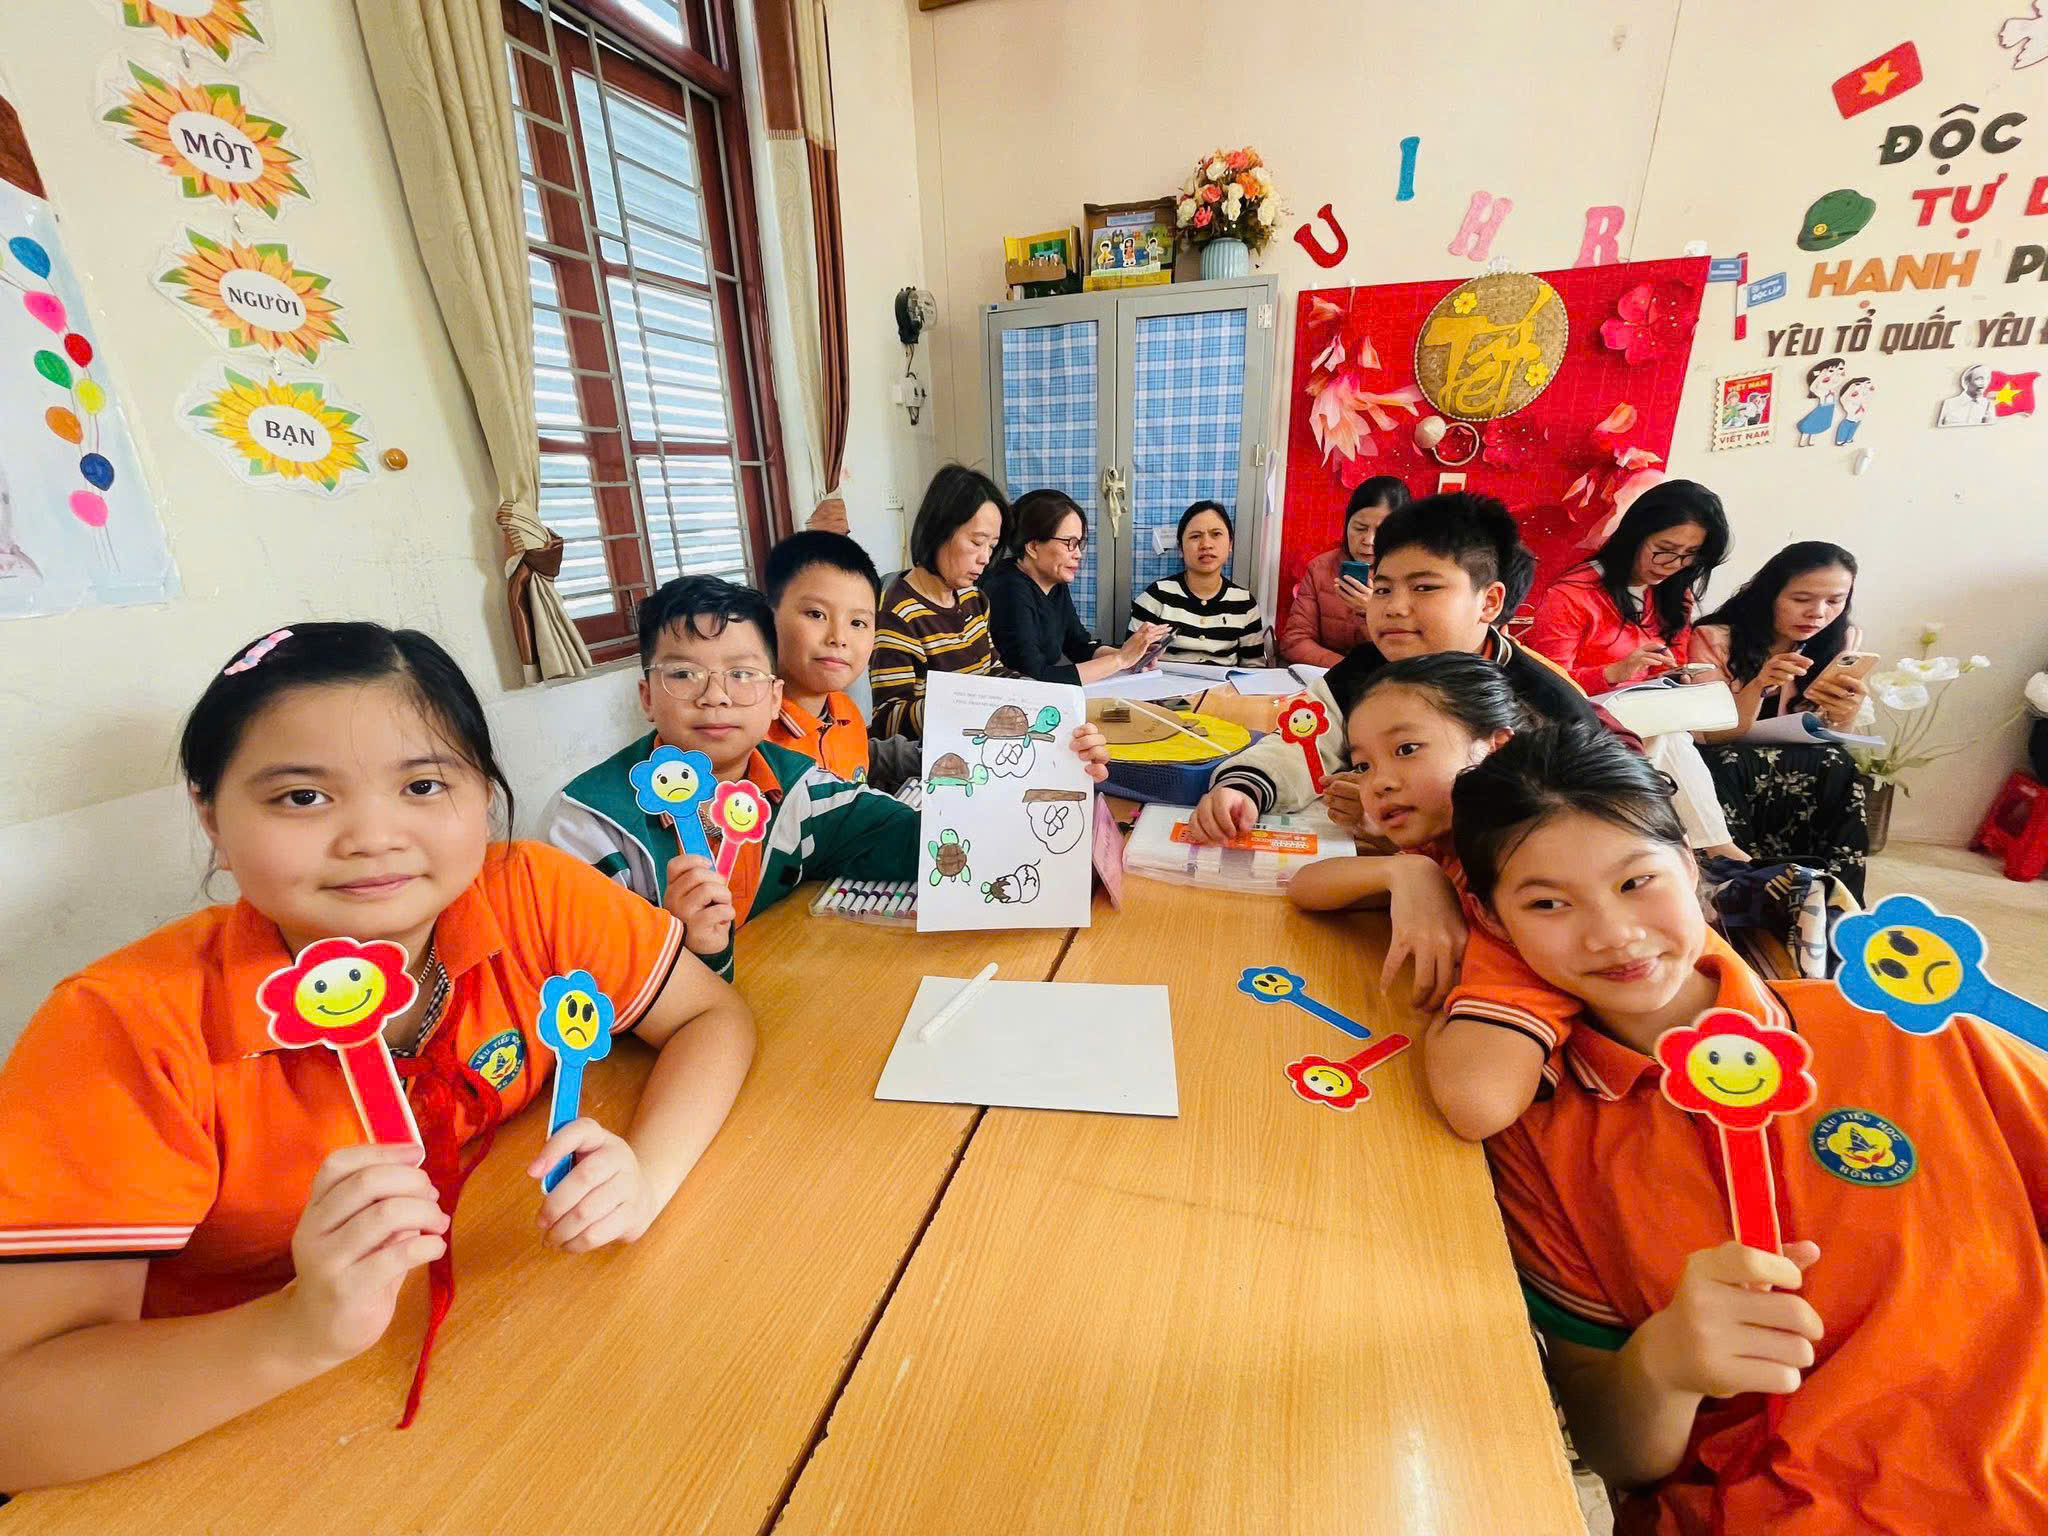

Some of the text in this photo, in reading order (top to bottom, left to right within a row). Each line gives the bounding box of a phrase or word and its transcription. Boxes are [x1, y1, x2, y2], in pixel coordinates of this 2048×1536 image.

[180, 128, 254, 169] MỘT
[1878, 103, 2027, 175] ĐỘC
[1912, 172, 2008, 239] TỰ
[228, 287, 299, 317] NGƯỜI
[1808, 249, 1982, 309] HẠNH
[1768, 322, 1824, 358] YÊU
[1834, 308, 1876, 354] TỔ
[1879, 305, 1963, 355] QUỐC
[1976, 311, 2036, 348] YÊU
[266, 420, 315, 447] BẠN
[1745, 430, 1769, 439] NAM
